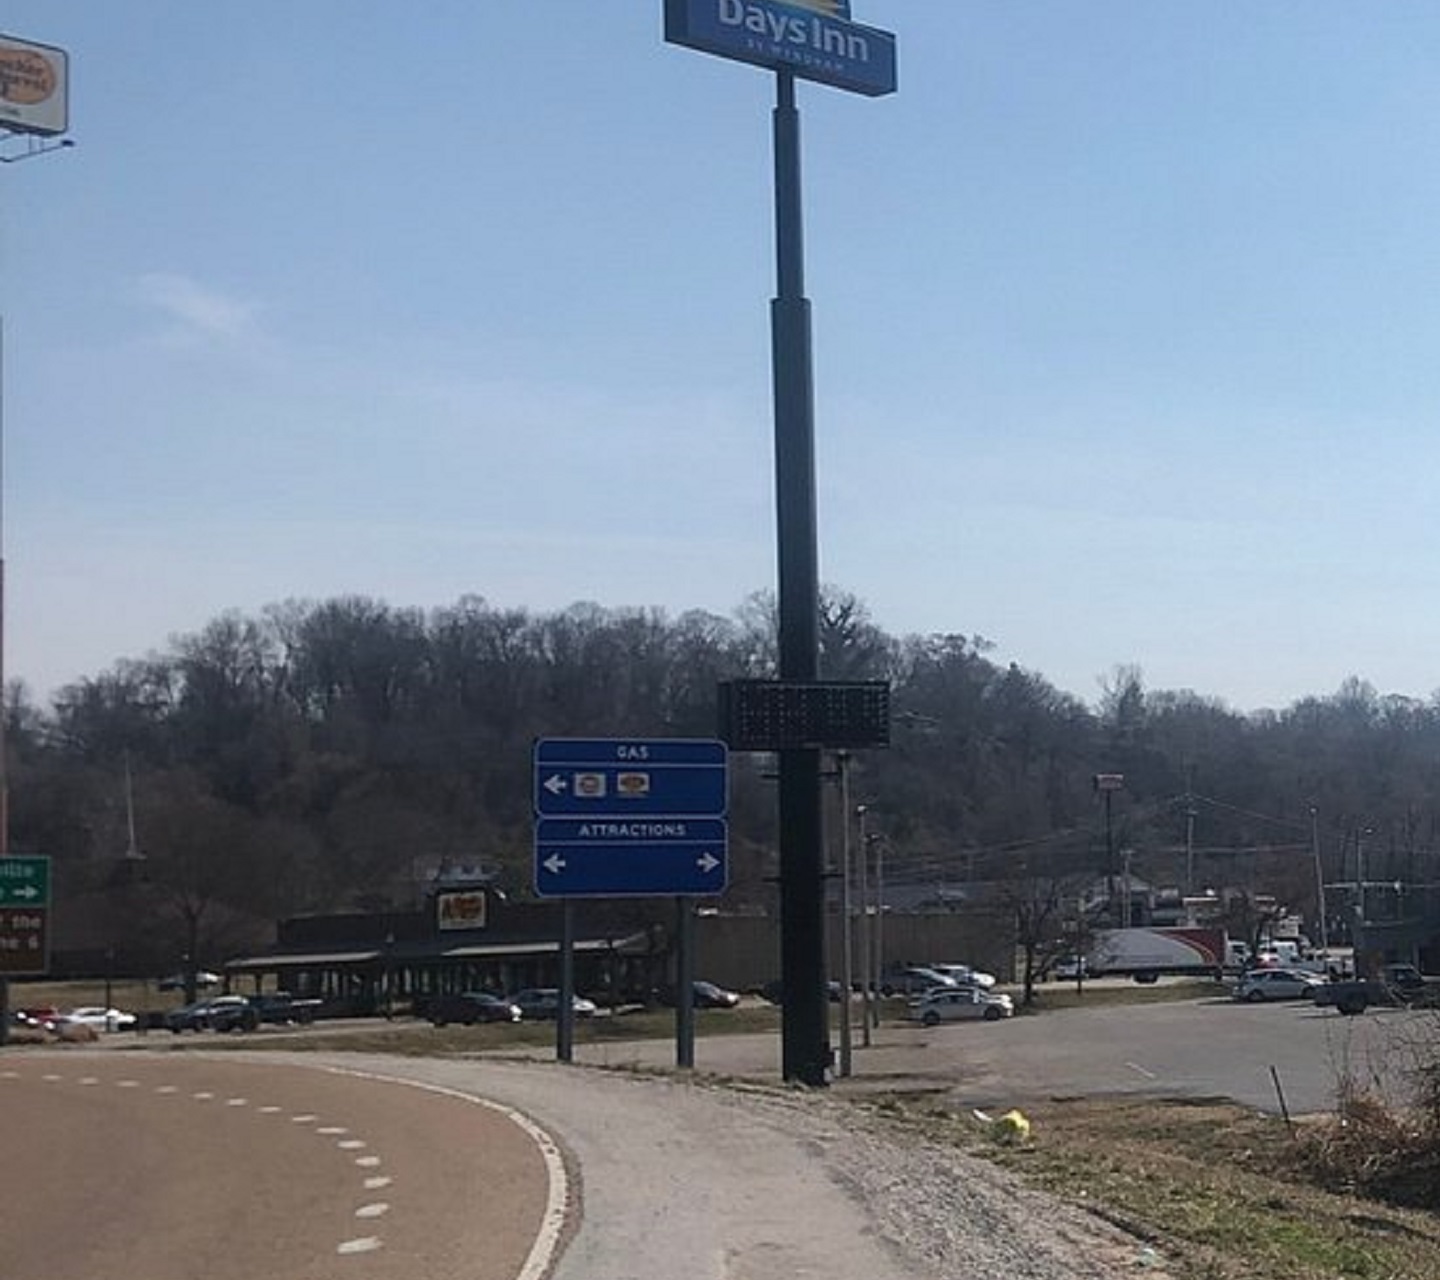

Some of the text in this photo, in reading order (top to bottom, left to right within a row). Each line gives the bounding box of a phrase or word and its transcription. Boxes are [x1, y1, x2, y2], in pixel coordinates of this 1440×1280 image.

[812, 18, 868, 61] Inn
[617, 745, 649, 759] GAS
[579, 824, 686, 837] ATTRACTIONS
